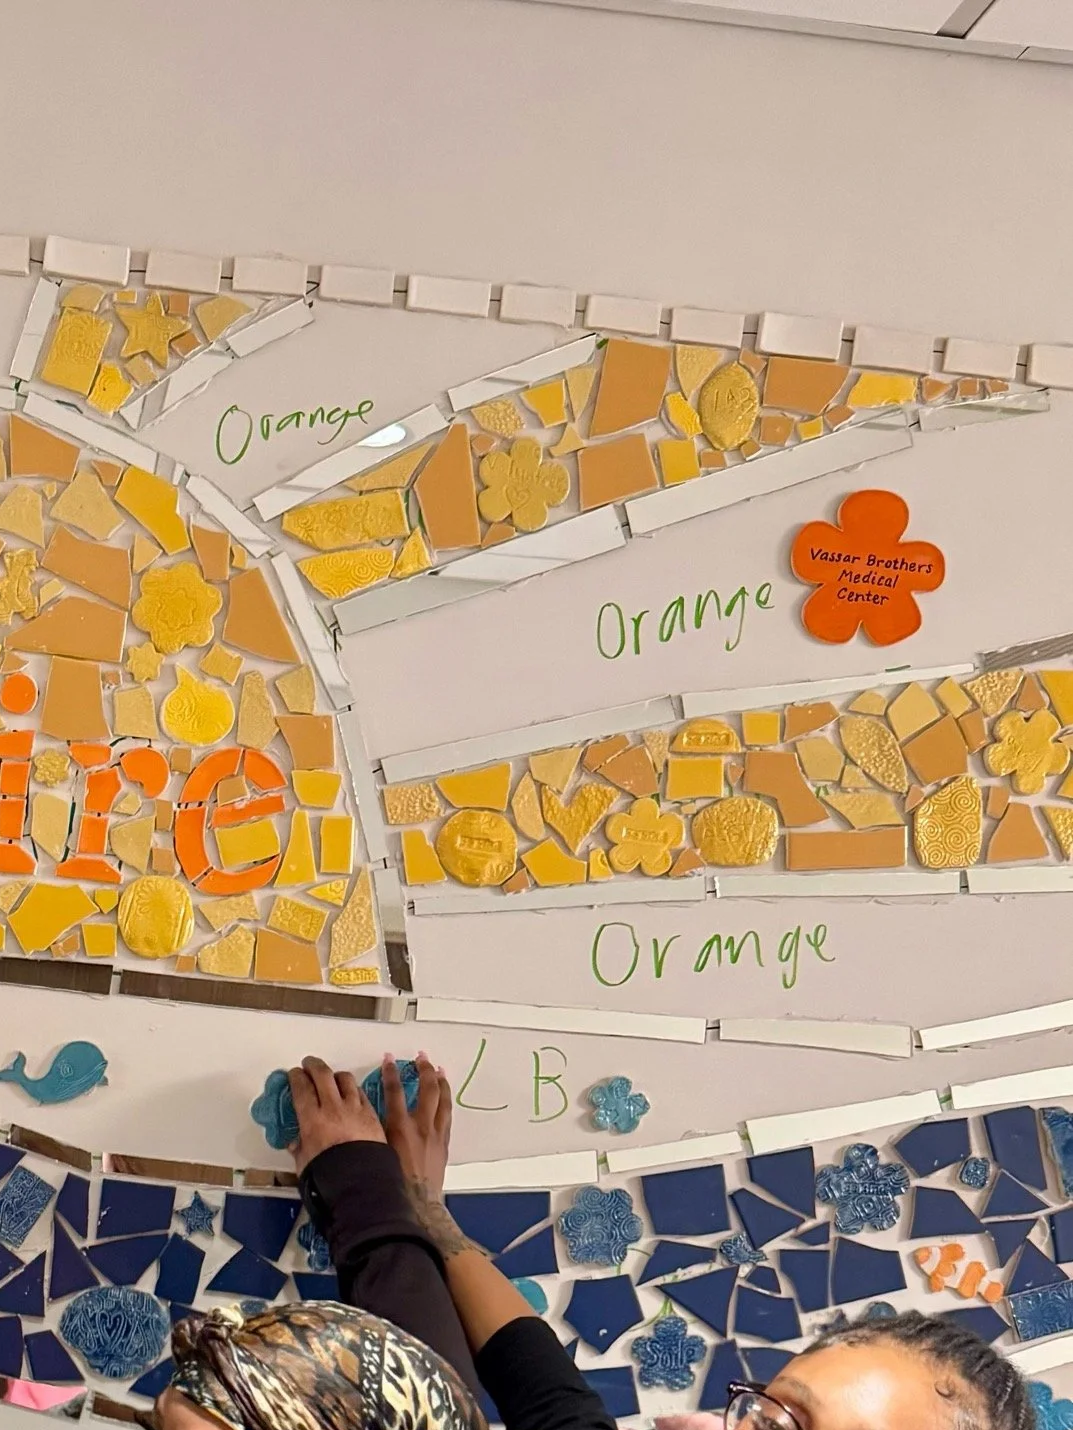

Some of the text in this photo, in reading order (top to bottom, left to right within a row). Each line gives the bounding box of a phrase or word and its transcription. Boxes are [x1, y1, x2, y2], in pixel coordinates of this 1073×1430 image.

[215, 397, 374, 464] Orange
[809, 547, 934, 574] Vassar Brothers
[837, 568, 899, 589] Medical
[836, 586, 890, 606] Center
[596, 582, 775, 661] Orange
[591, 921, 836, 990] Orange
